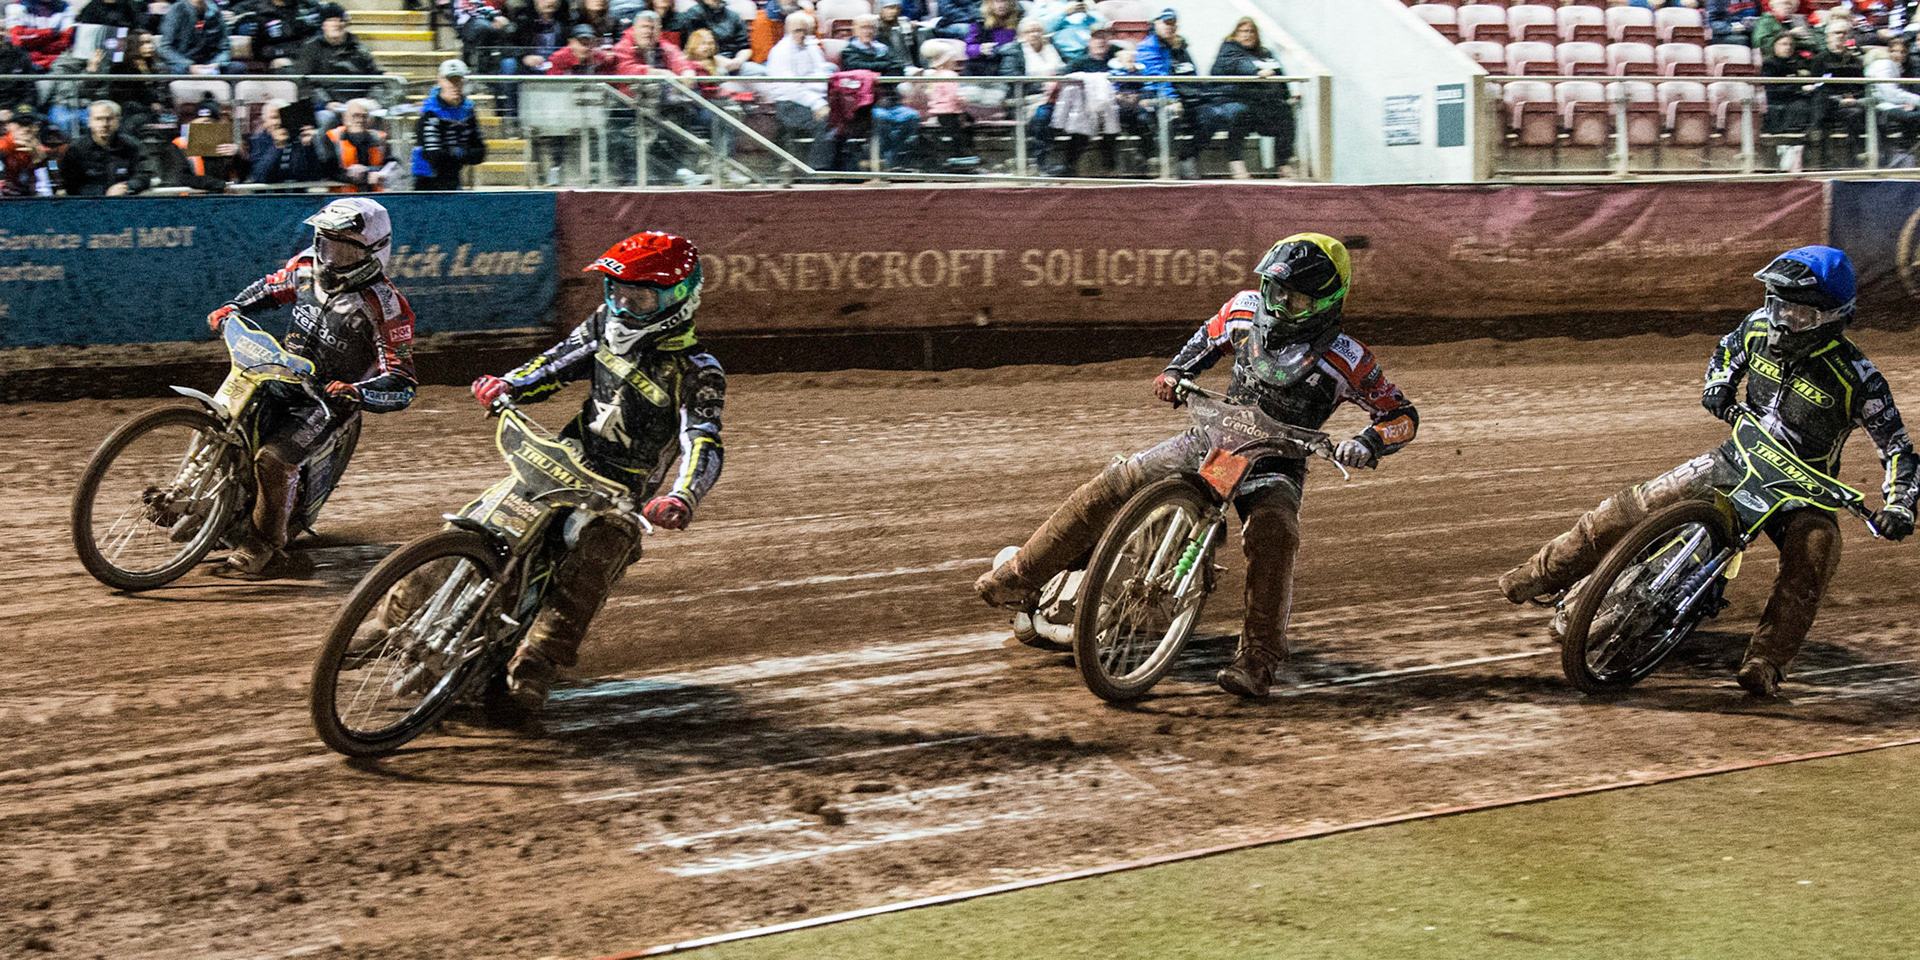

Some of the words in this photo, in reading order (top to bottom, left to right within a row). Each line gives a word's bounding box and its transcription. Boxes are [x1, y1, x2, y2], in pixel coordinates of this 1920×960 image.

[86, 226, 133, 249] and
[136, 225, 196, 248] MOT
[0, 261, 65, 282] orton
[386, 244, 448, 279] ick
[448, 243, 544, 277] Lane
[699, 249, 1005, 293] ORNEYCROFT
[1019, 248, 1249, 287] SOLICITORS
[1305, 372, 1321, 387] 4
[1789, 377, 1827, 404] MIX
[1222, 415, 1270, 439] Crendon
[521, 446, 553, 470] TRU
[549, 464, 592, 490] MIX
[1757, 445, 1787, 467] TRU
[1783, 465, 1819, 491] MIX
